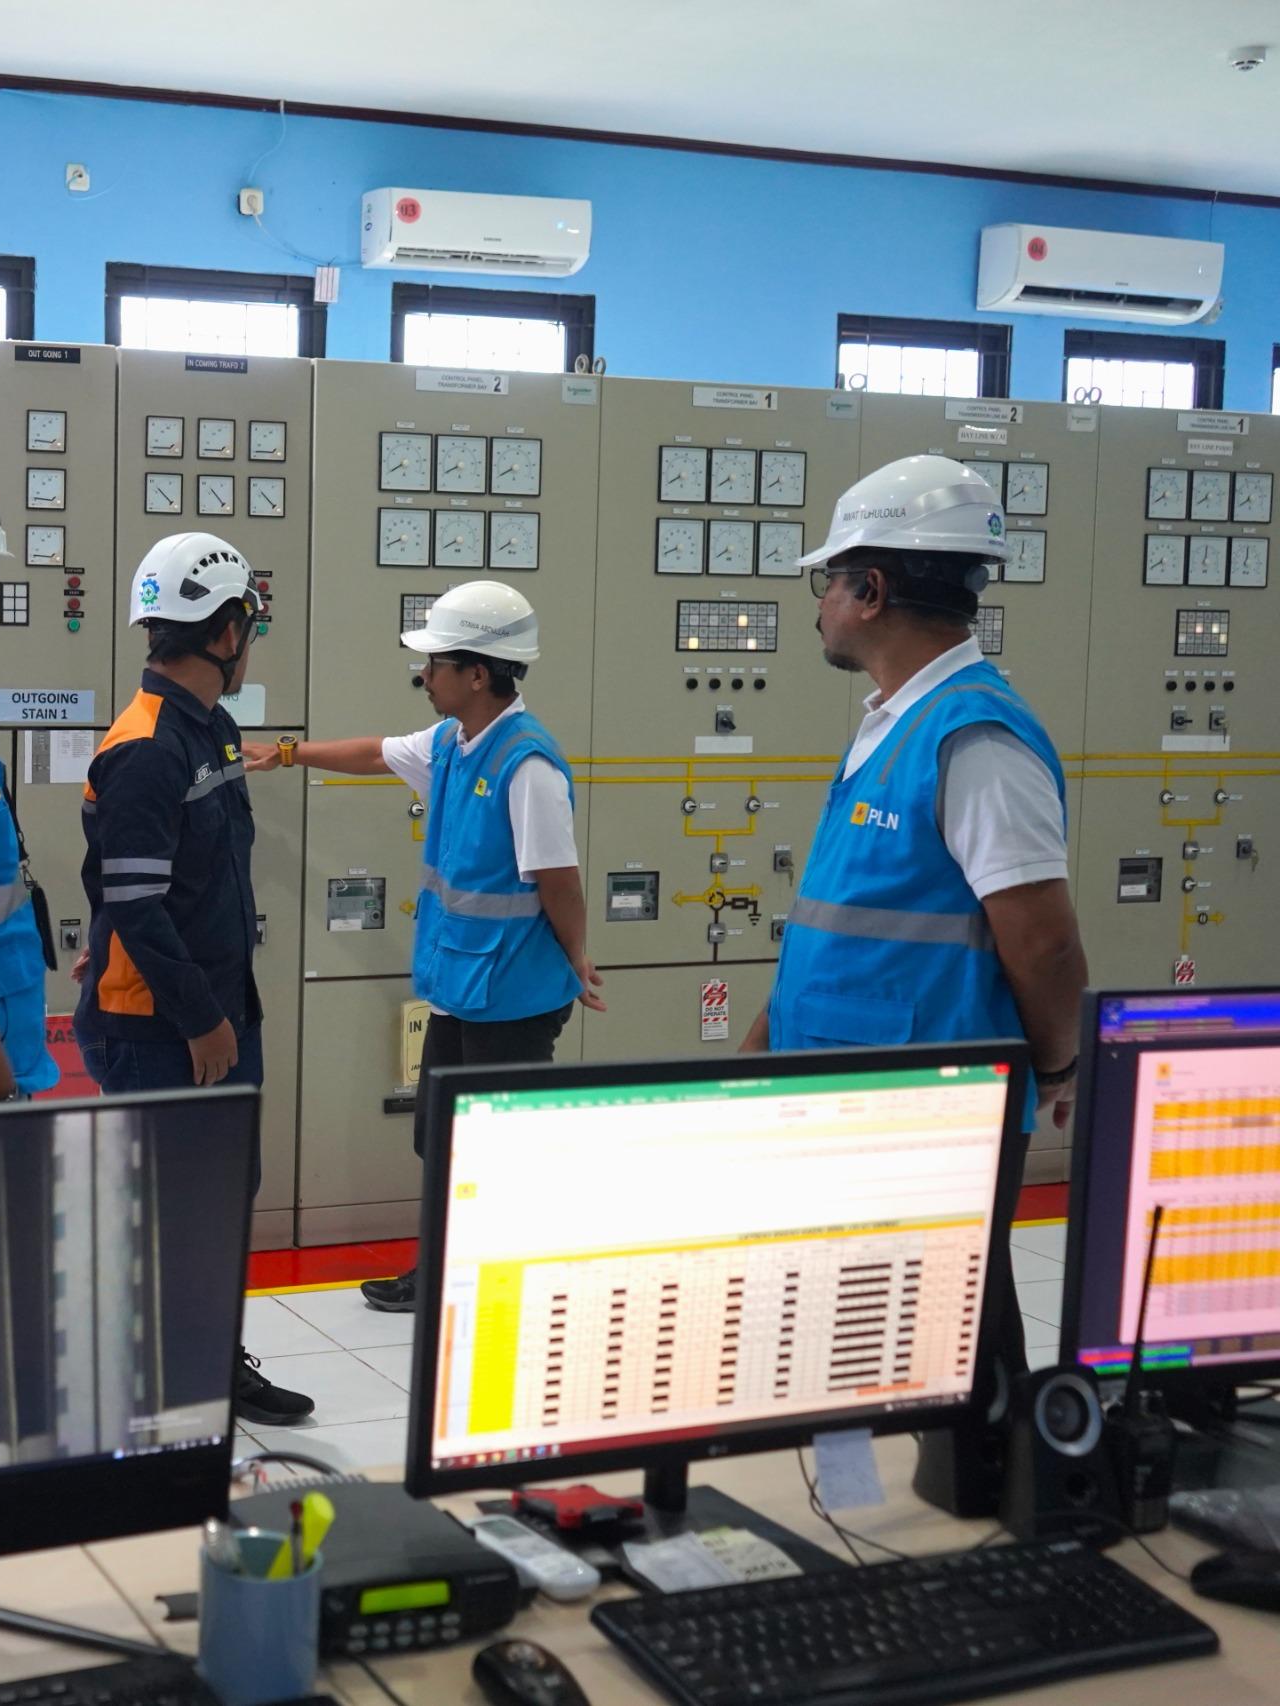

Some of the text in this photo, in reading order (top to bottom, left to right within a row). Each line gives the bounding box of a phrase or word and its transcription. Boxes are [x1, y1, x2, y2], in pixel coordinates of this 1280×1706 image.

[28, 350, 68, 359] OUT GOING 1
[187, 359, 194, 367] IN
[195, 359, 218, 369] COMING
[493, 376, 502, 392] 2
[765, 392, 772, 408] 1
[1010, 406, 1018, 422] 2
[1237, 418, 1244, 433] 1
[11, 692, 79, 704] OUTGOING
[22, 708, 68, 720] STAIN 1
[866, 807, 900, 830] PLN
[409, 1019, 422, 1033] IN
